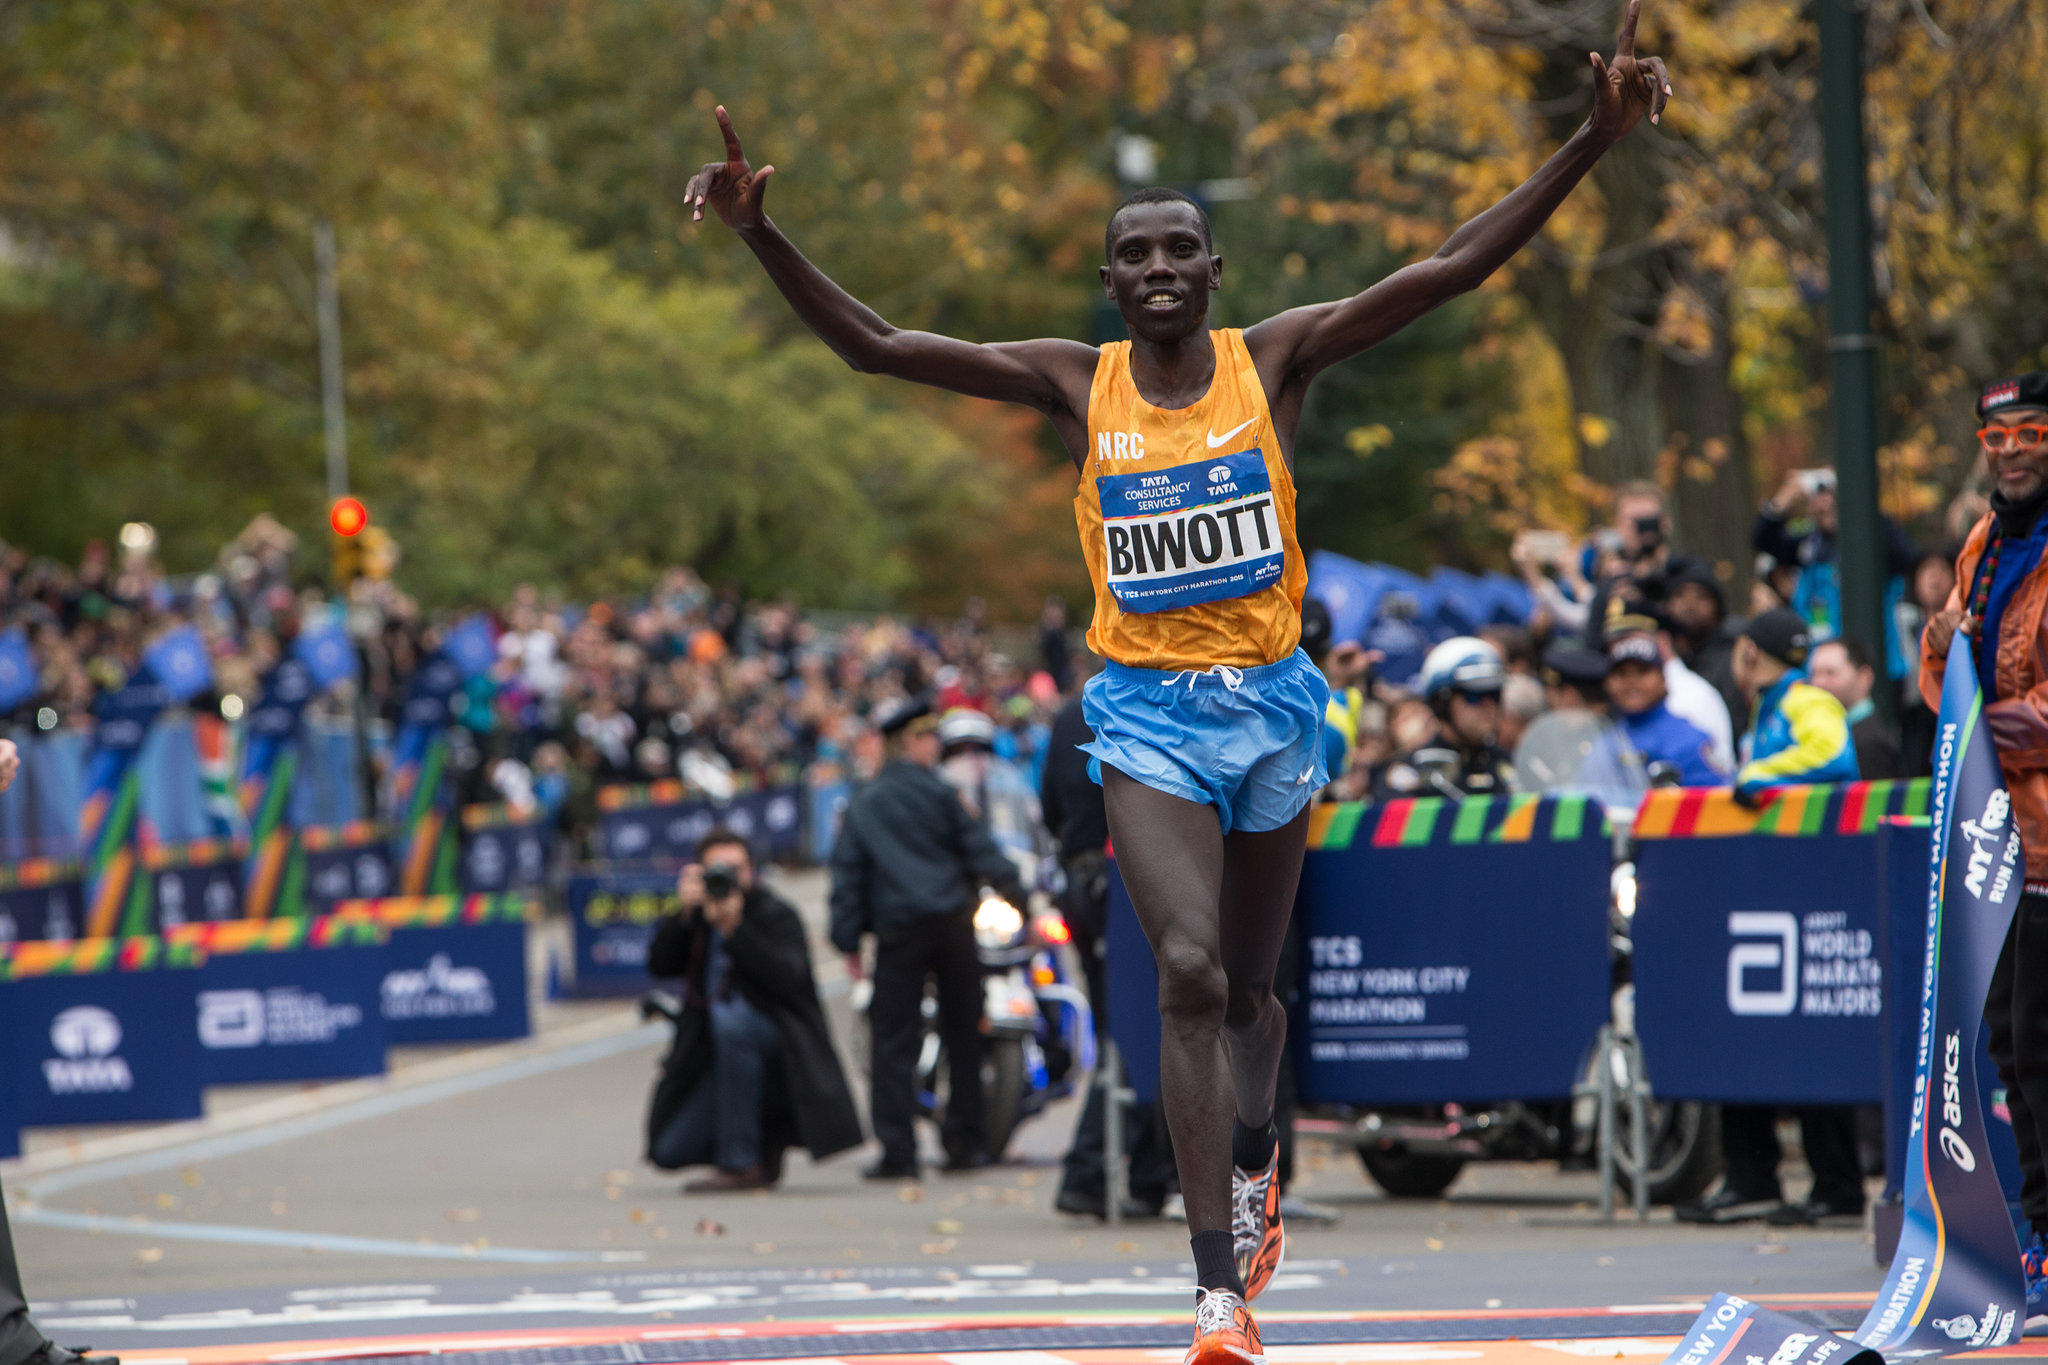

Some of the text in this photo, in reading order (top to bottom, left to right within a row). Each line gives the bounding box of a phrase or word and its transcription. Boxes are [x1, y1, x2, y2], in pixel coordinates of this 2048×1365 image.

[1097, 431, 1145, 461] NRC
[1124, 481, 1191, 501] CONSULTANCY
[1140, 475, 1171, 488] TATA
[1206, 482, 1238, 497] TATA
[1137, 495, 1181, 511] SERVICES
[1108, 498, 1272, 576] BIWOTT
[1124, 590, 1139, 599] TCS
[1140, 590, 1155, 598] NEW
[1155, 587, 1174, 595] YORK
[1173, 584, 1190, 593] CITY
[1189, 577, 1228, 590] MARATHON
[1988, 864, 2014, 905] RUN
[2003, 831, 2021, 866] FOR
[1803, 929, 1872, 960] WORLD
[1911, 722, 1957, 1139] TCS NEW YORK CITY MARATHON
[1309, 936, 1362, 968] TCS
[1309, 966, 1470, 995] NEW YORK CITY
[1309, 997, 1426, 1024] MARATHON
[1877, 1257, 1926, 1338] MARATHON
[1676, 1332, 1716, 1365] EW
